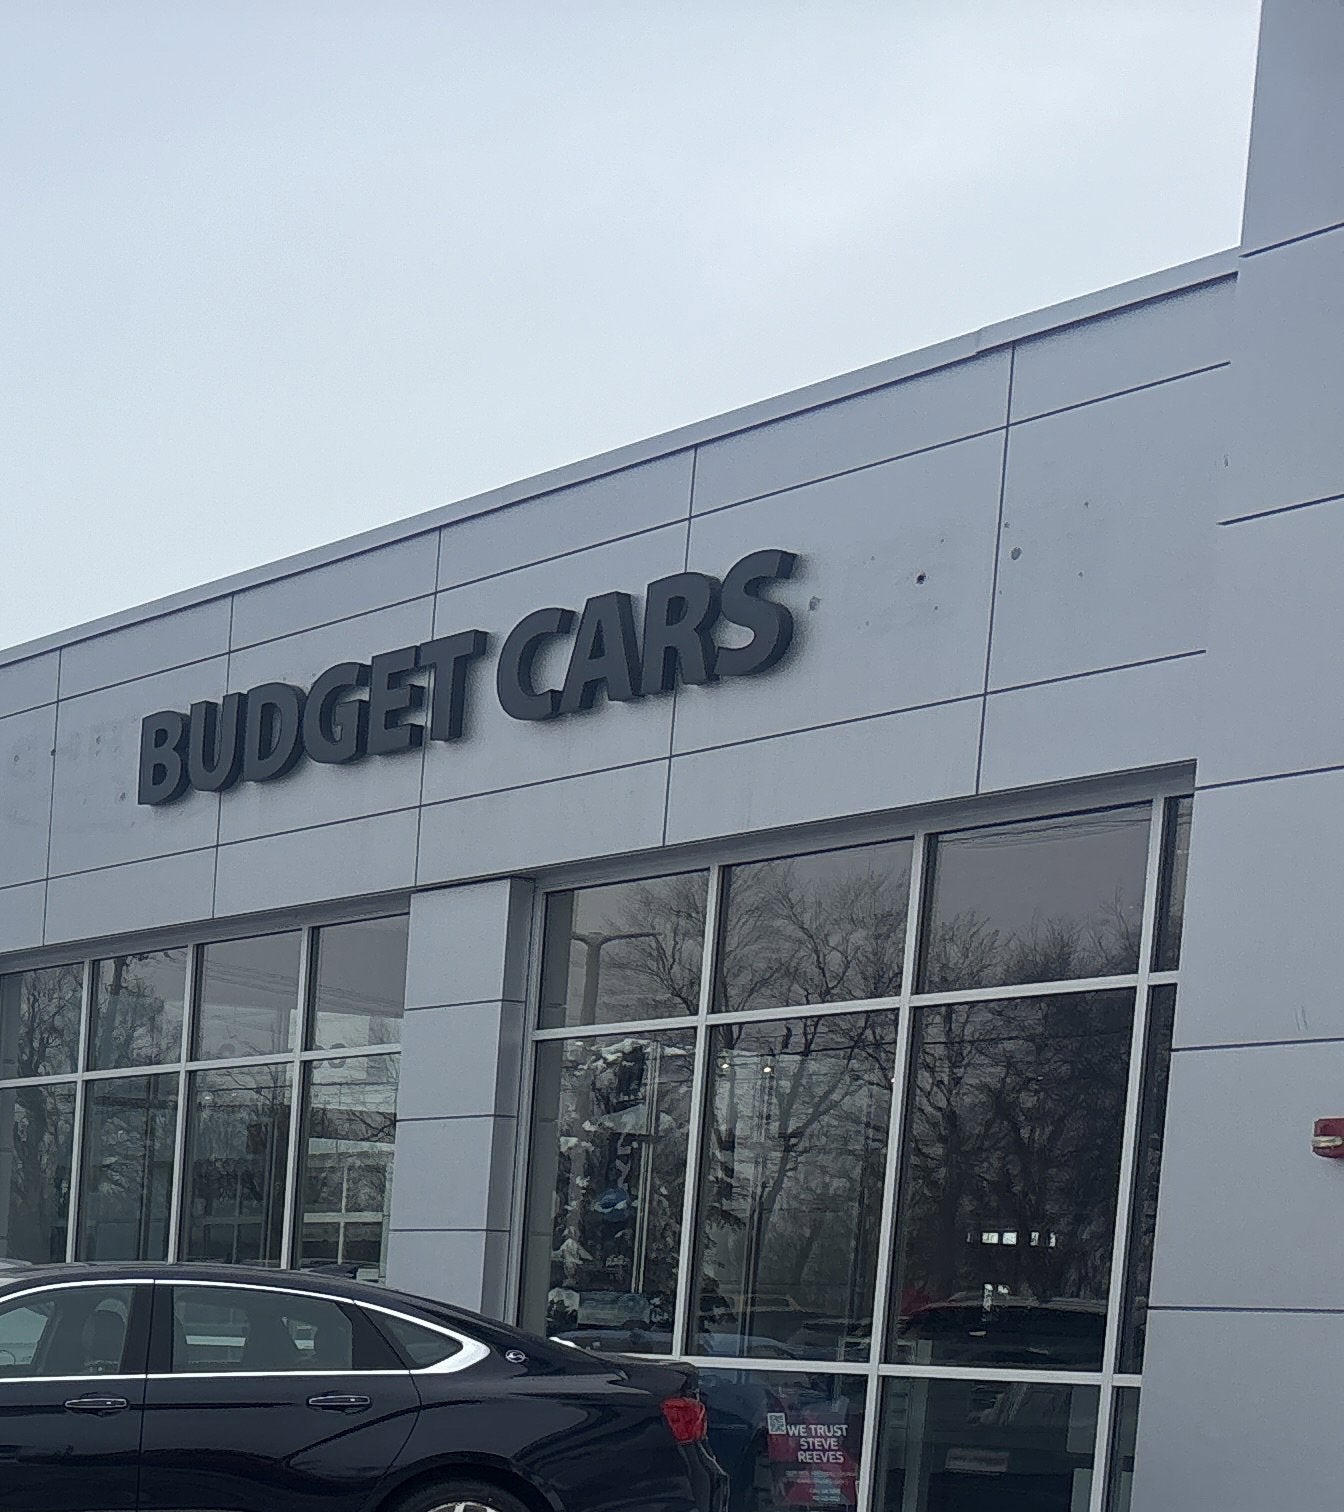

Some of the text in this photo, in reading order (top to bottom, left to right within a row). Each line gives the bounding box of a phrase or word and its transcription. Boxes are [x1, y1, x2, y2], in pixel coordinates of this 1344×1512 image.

[138, 549, 800, 806] BUDGET CARS
[786, 1424, 849, 1437] WE TRUST
[799, 1438, 839, 1450] STEVE
[797, 1451, 845, 1463] REEVES
